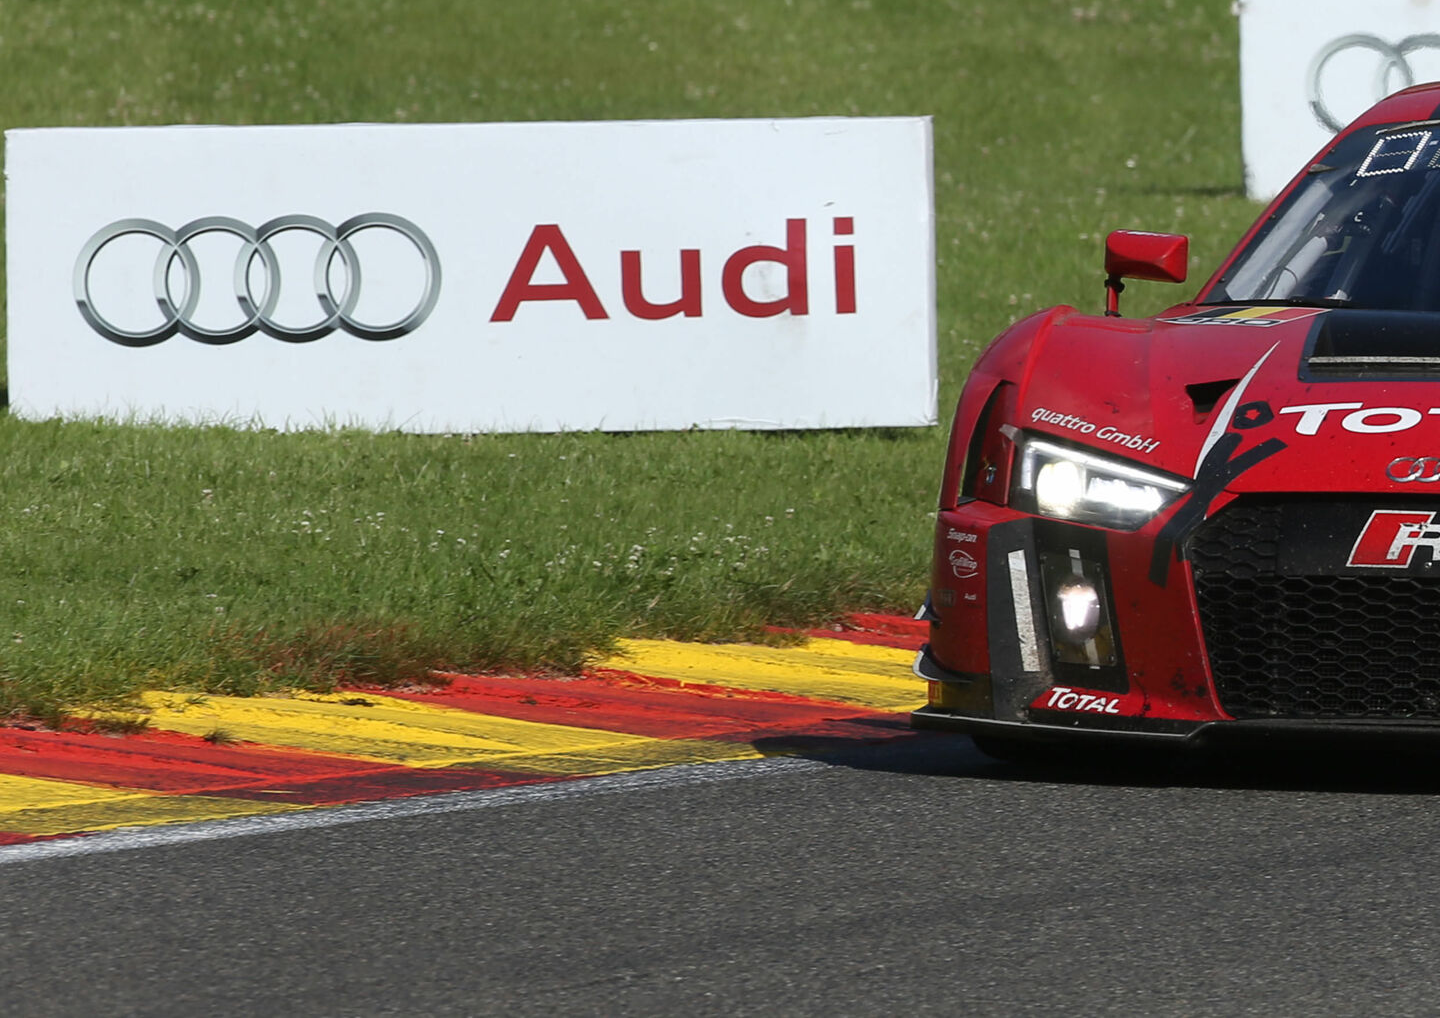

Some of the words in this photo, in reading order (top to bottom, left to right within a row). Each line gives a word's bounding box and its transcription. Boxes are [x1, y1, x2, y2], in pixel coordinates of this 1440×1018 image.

[489, 216, 857, 323] Audi
[1030, 406, 1093, 438] quattro
[1095, 424, 1160, 455] GmbH
[1047, 686, 1121, 714] TOTAL
